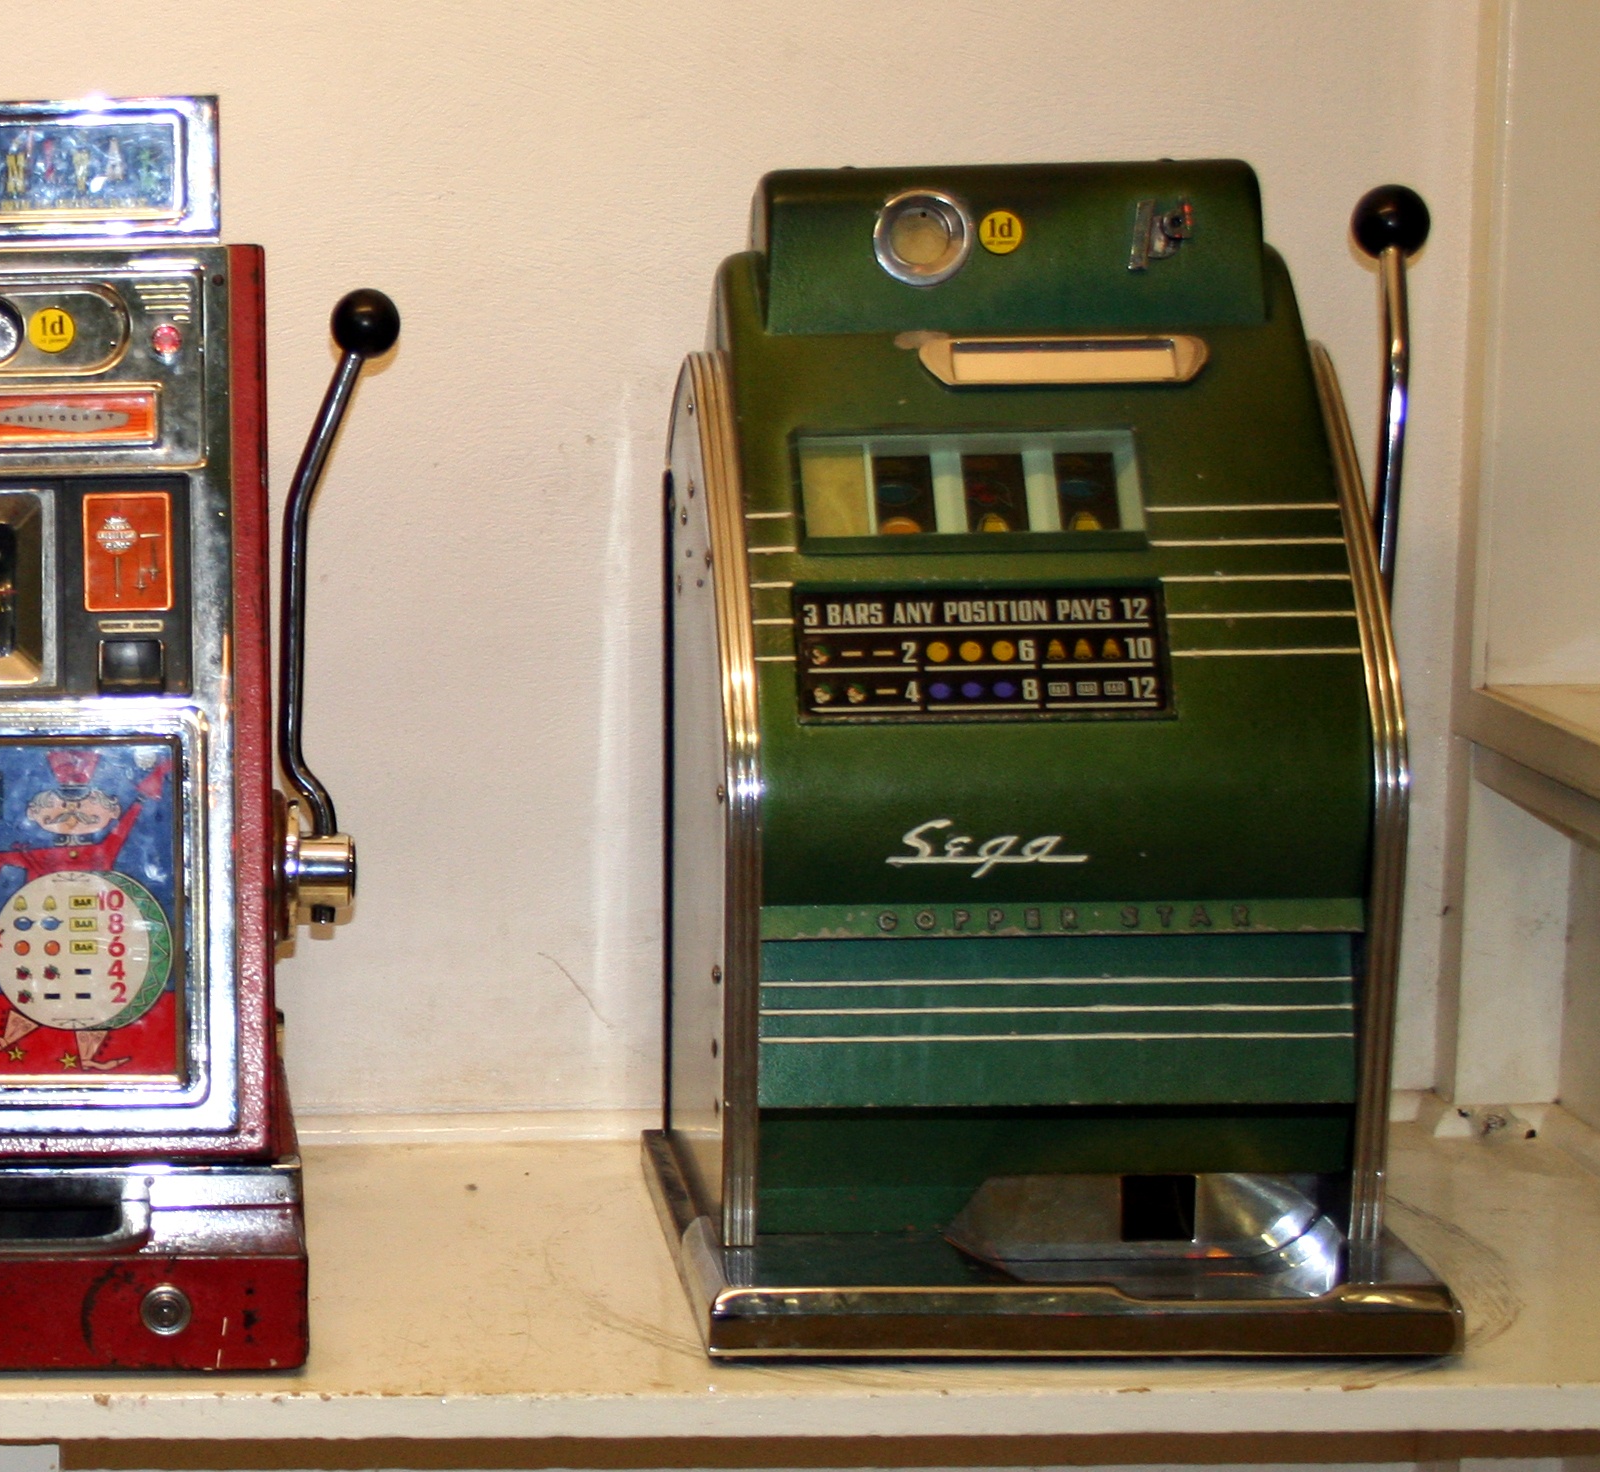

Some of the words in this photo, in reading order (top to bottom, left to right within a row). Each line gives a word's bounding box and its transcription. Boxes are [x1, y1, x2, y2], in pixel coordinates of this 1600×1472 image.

[989, 218, 1013, 238] 1d
[41, 315, 65, 336] 1d
[3, 413, 115, 423] ARISTOCRAT
[803, 604, 818, 626] 3
[826, 603, 883, 626] BARS
[893, 602, 933, 624] ANY
[944, 600, 1047, 623] POSITION
[1056, 599, 1112, 621] PAYS
[1120, 598, 1148, 619] 12
[901, 642, 917, 663] 2
[1018, 640, 1035, 661] 6
[1124, 638, 1153, 659] 10
[905, 681, 921, 702] 4
[1022, 679, 1039, 700] 8
[1128, 677, 1156, 699] 12
[887, 819, 1082, 879] Sega
[72, 897, 93, 908] BAR
[97, 889, 125, 911] 10
[73, 918, 94, 929] BAR
[108, 913, 124, 934] 8
[875, 907, 1078, 933] COPPER
[1120, 904, 1250, 927] STAR
[73, 941, 94, 952] BAR
[108, 936, 125, 957] 6
[108, 960, 125, 981] 4
[109, 982, 127, 1003] 2
